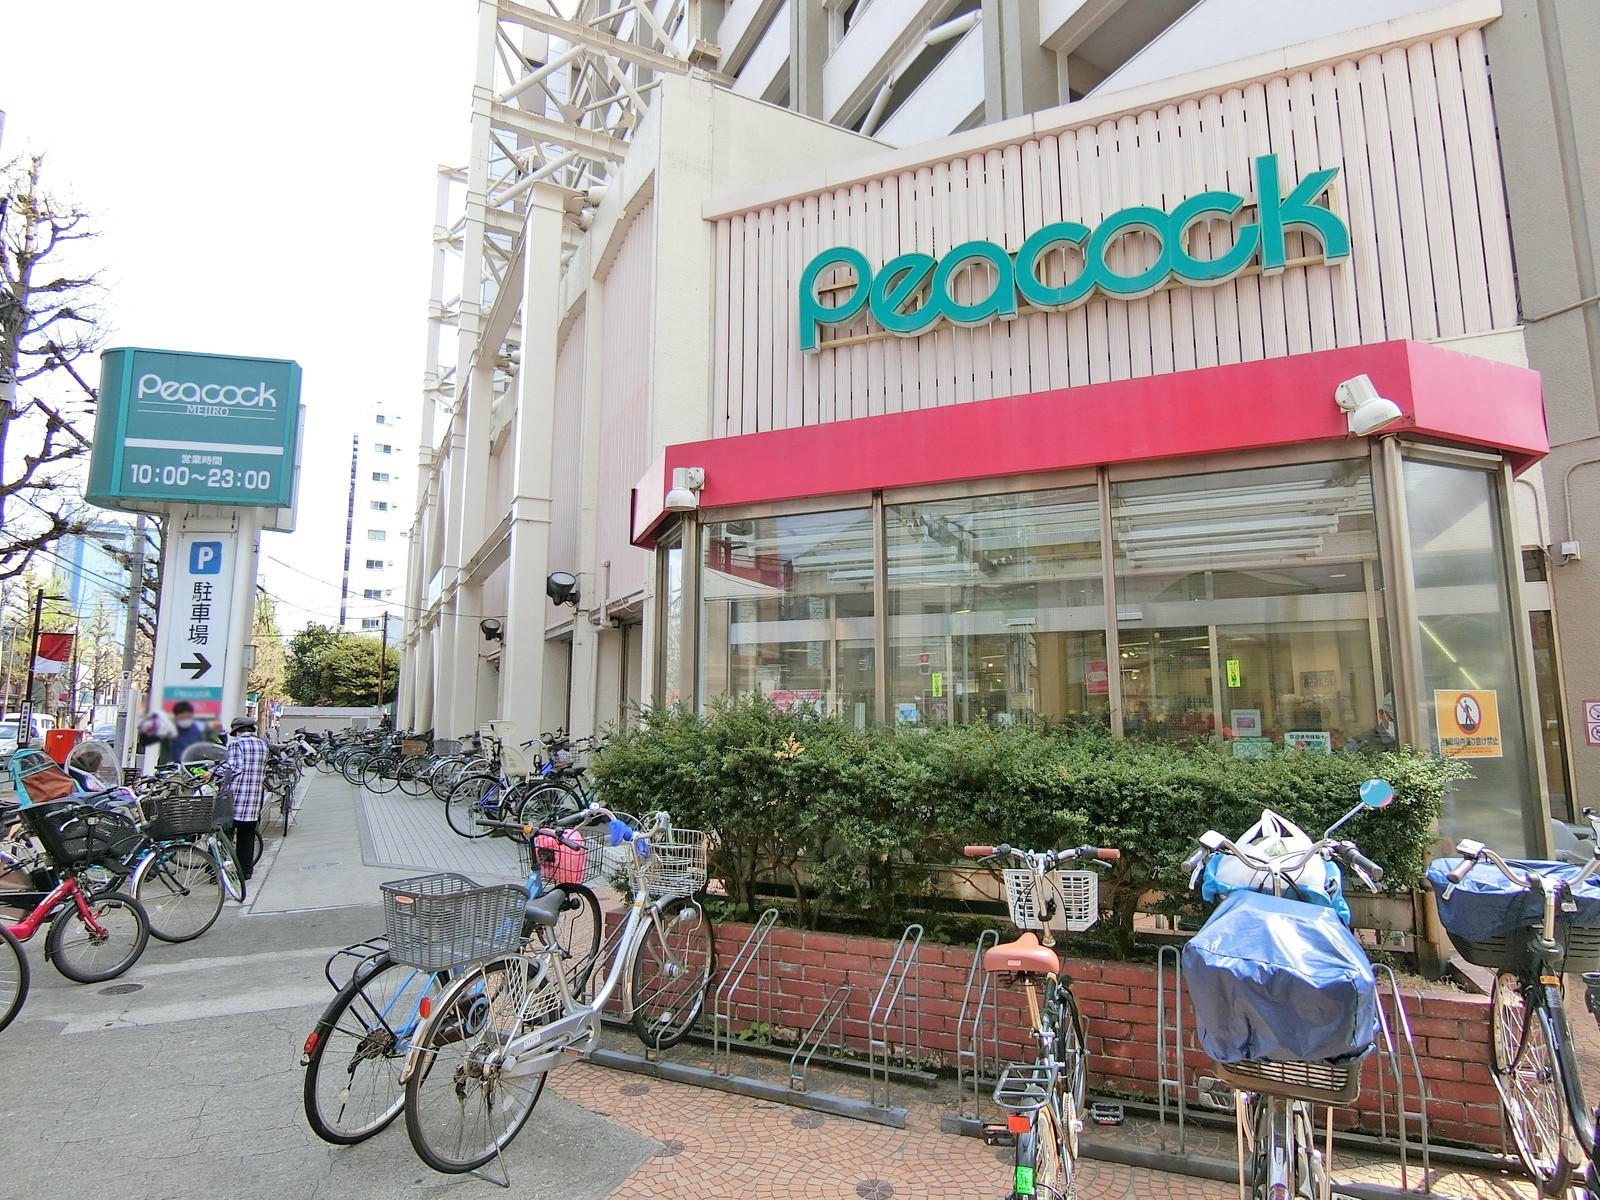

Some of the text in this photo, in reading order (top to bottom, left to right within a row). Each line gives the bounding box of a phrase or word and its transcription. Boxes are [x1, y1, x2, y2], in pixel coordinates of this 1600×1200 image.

[799, 152, 1350, 355] Peacock
[138, 373, 276, 407] Peacock
[186, 404, 229, 417] MEJIRO
[181, 454, 223, 466] 営業時間
[187, 581, 213, 646] 駐車場
